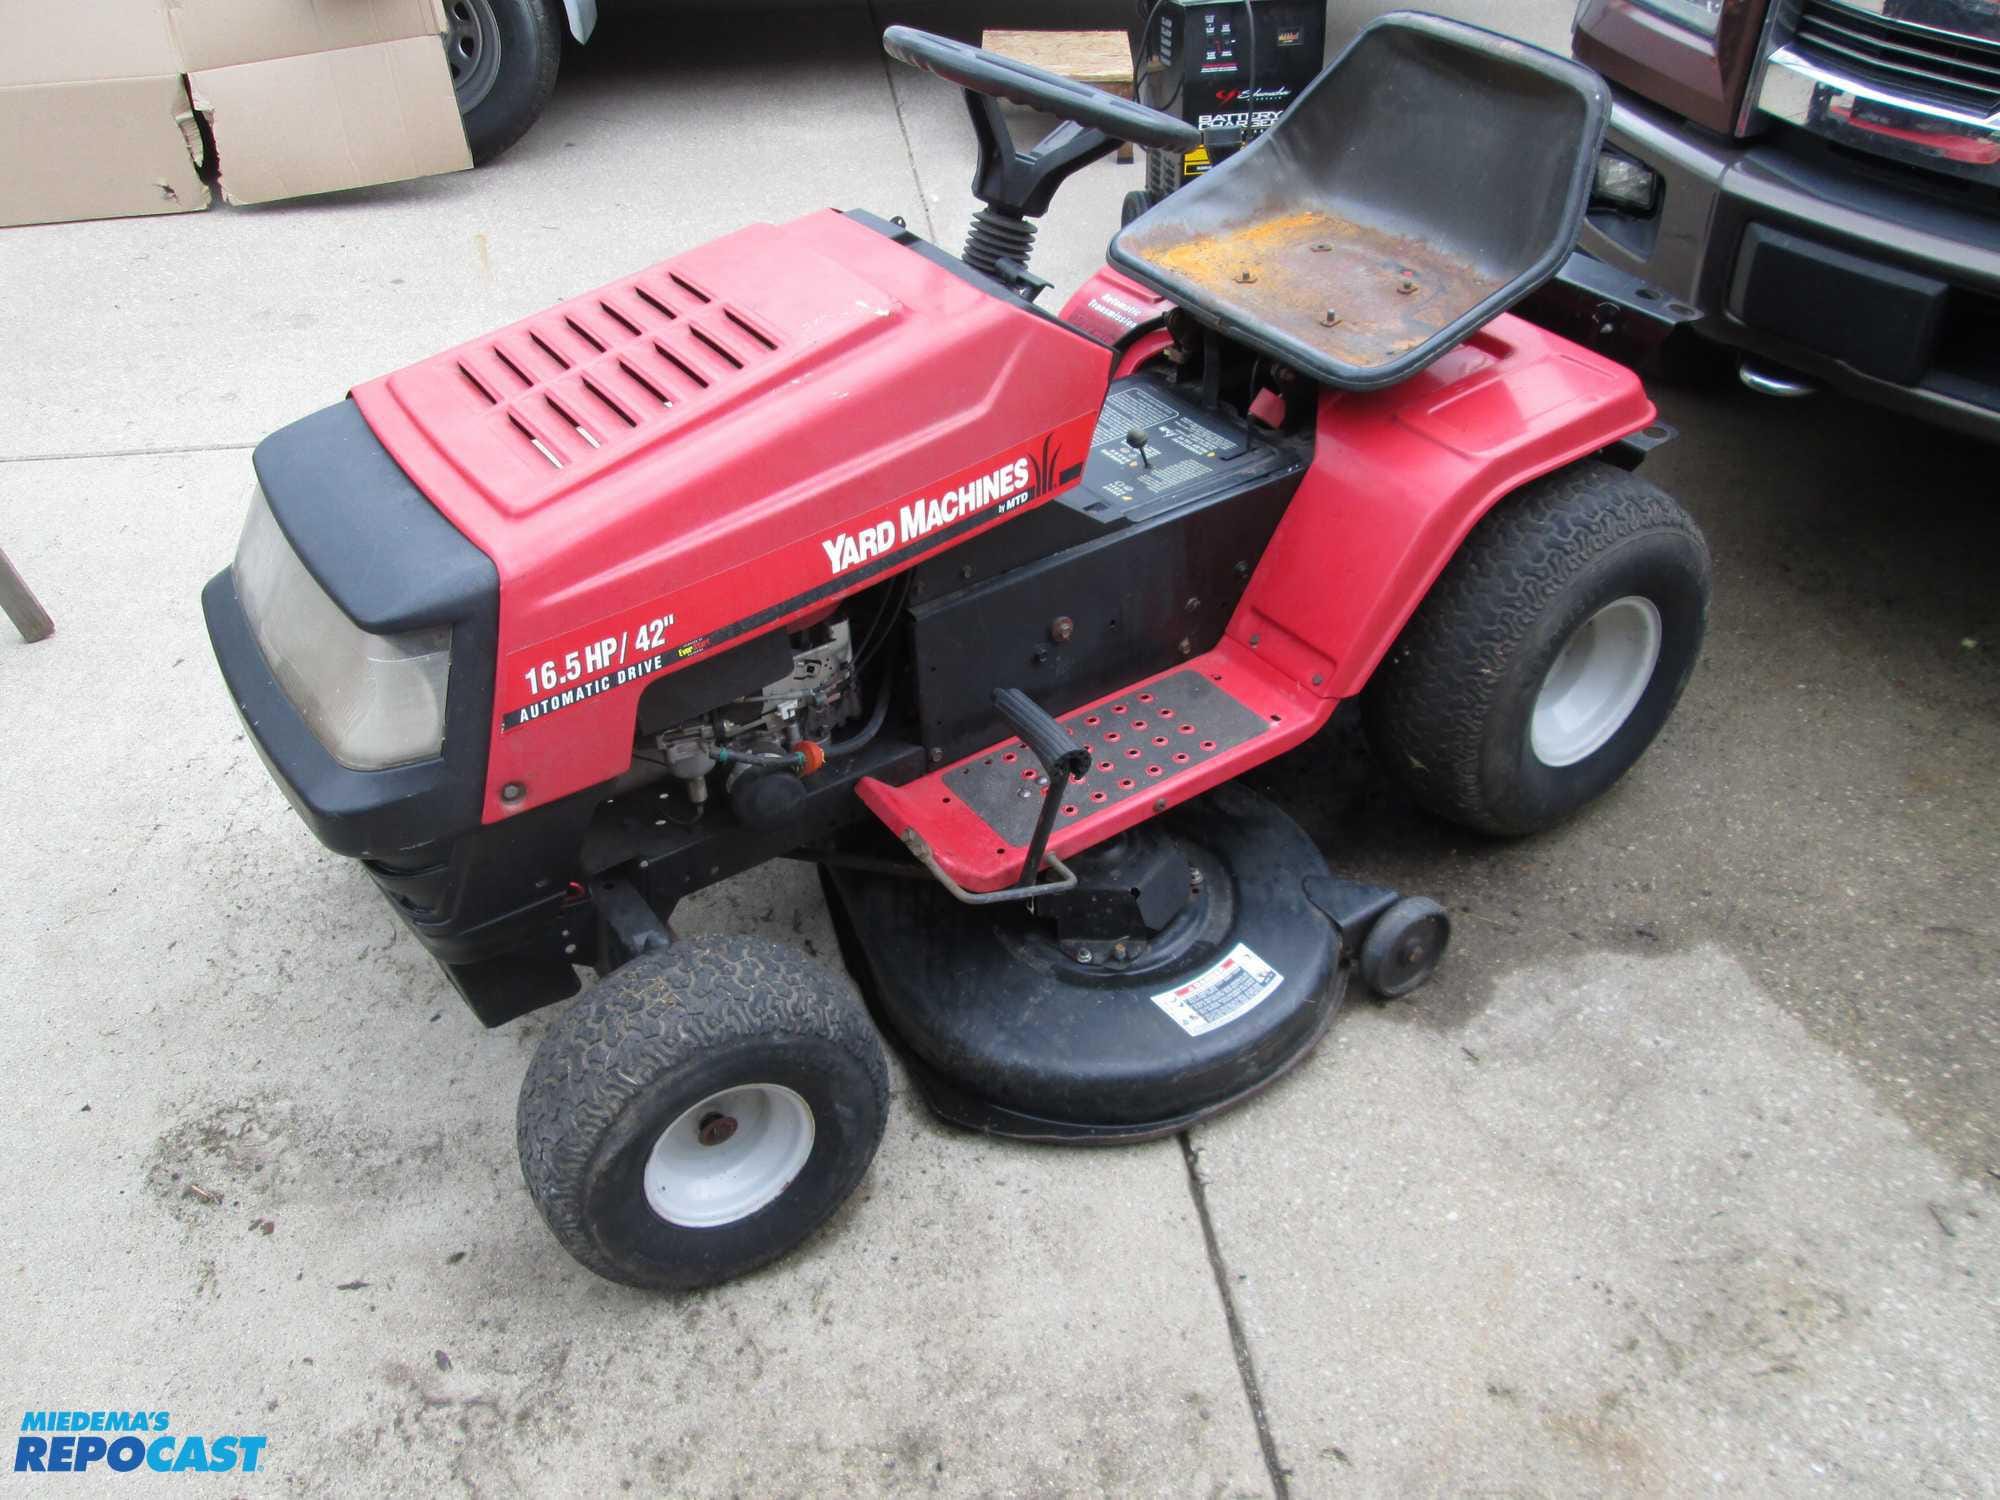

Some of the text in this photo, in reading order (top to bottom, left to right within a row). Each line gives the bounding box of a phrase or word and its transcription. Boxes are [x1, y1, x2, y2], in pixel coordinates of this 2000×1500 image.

[1199, 110, 1283, 124] BATTERY
[821, 457, 1030, 575] YARD MACHINES
[1006, 491, 1029, 512] MTD
[525, 651, 582, 695] 16.5
[634, 613, 675, 652] 42"
[519, 655, 663, 723] AUTOMATIC DRIVE
